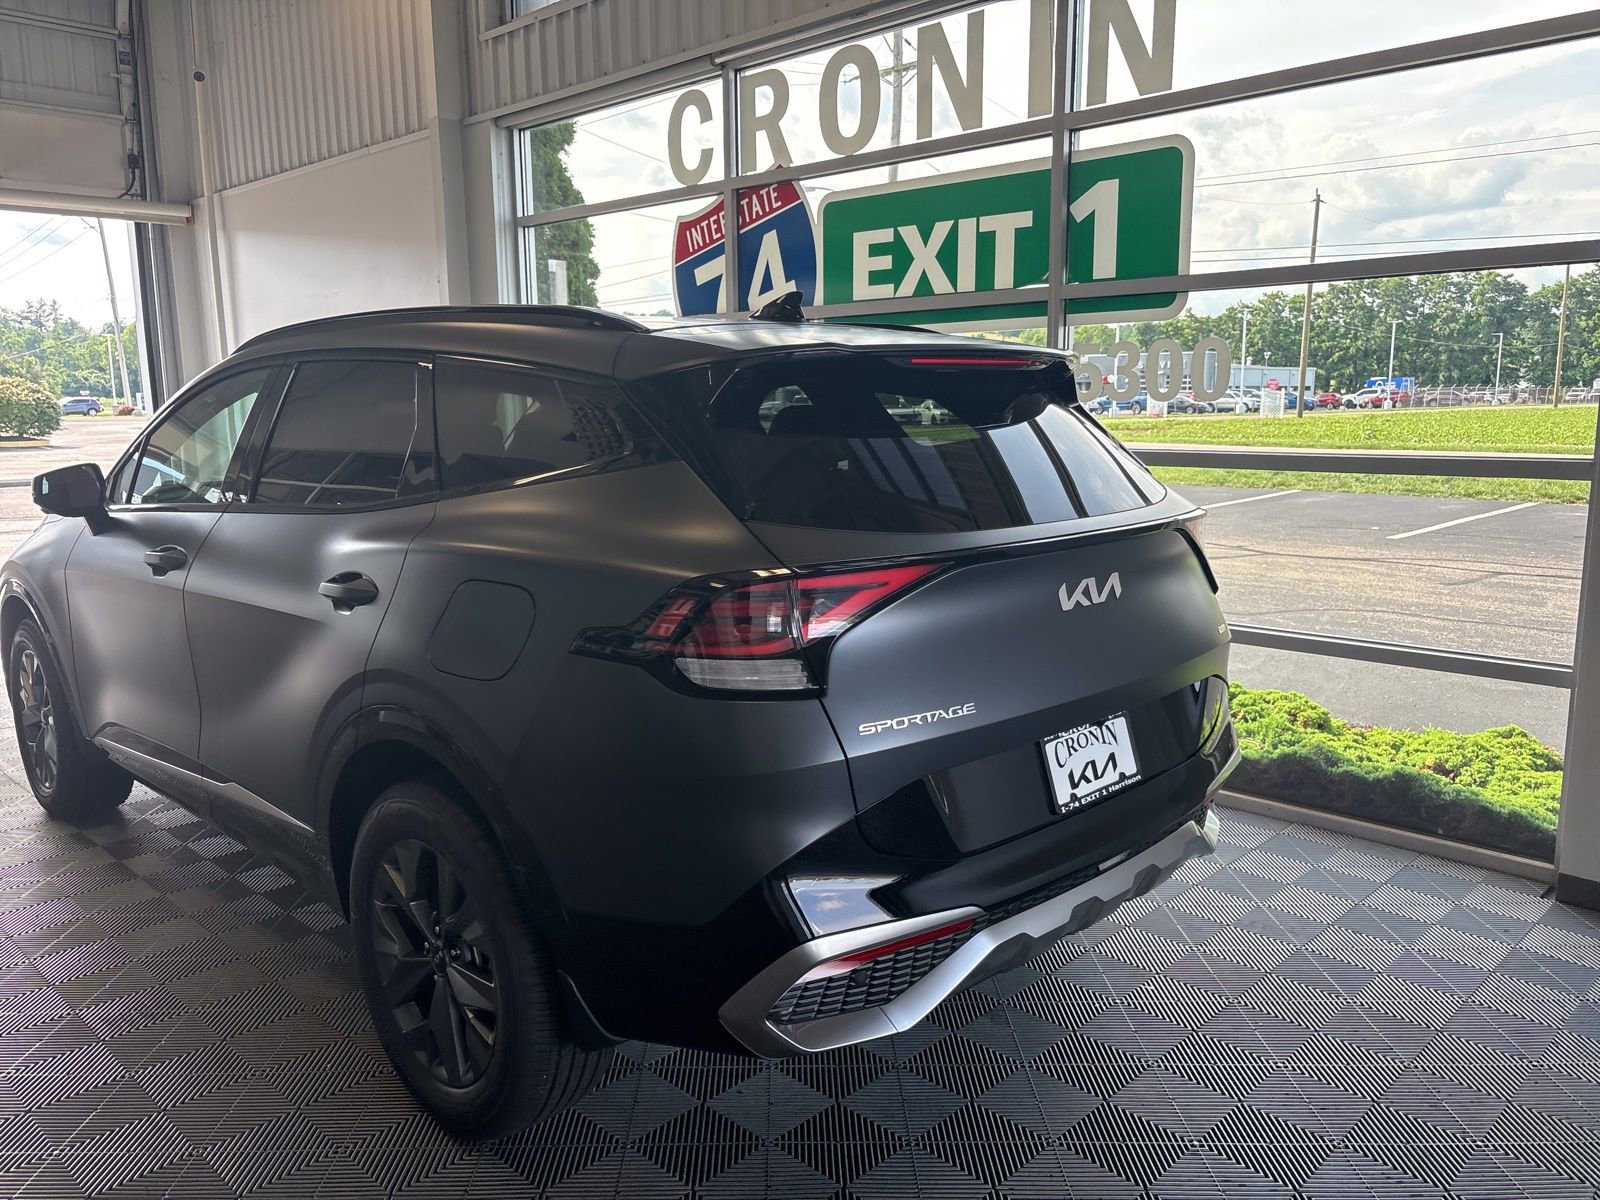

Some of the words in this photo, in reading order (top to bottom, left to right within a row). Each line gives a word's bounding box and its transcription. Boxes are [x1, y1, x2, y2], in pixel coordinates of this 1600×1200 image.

[667, 0, 1176, 186] CRONIN
[686, 184, 782, 253] INTETATE
[853, 211, 1033, 301] EXIT
[1069, 179, 1119, 280] 1
[694, 229, 797, 316] 74
[1073, 336, 1232, 402] 5300
[1059, 572, 1121, 611] KIA
[858, 702, 977, 736] SPORTAGE
[1054, 721, 1119, 769] CRONIN
[1060, 800, 1080, 814] I-74
[1081, 791, 1101, 805] EXIT
[1101, 788, 1108, 796] 1
[1108, 774, 1142, 792] Harrison
[1067, 751, 1118, 791] KIA
